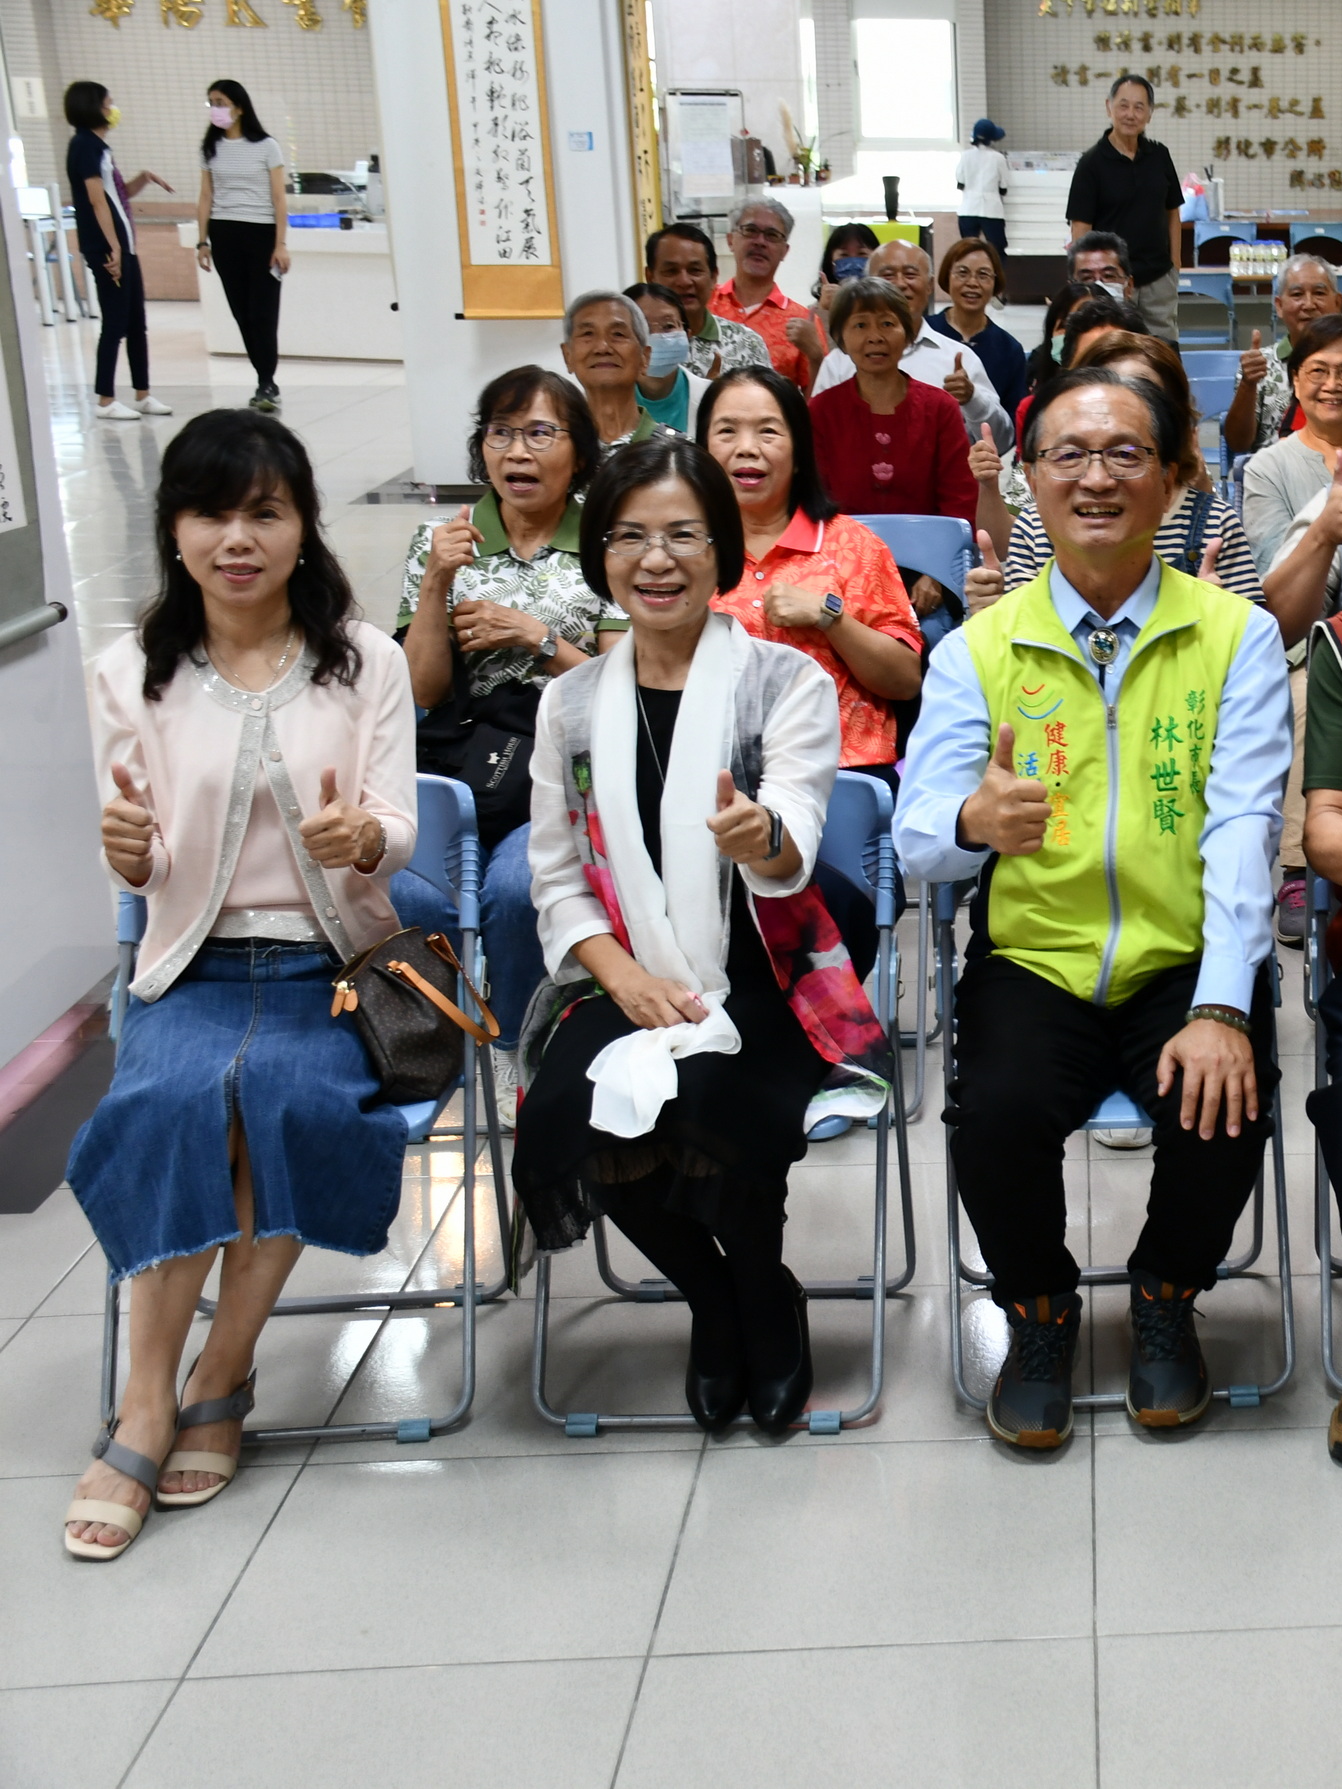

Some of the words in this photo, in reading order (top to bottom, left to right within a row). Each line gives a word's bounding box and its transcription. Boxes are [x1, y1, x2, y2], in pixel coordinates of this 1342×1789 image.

[1149, 714, 1186, 837] 林世賢
[1184, 689, 1206, 795] 彰化市長
